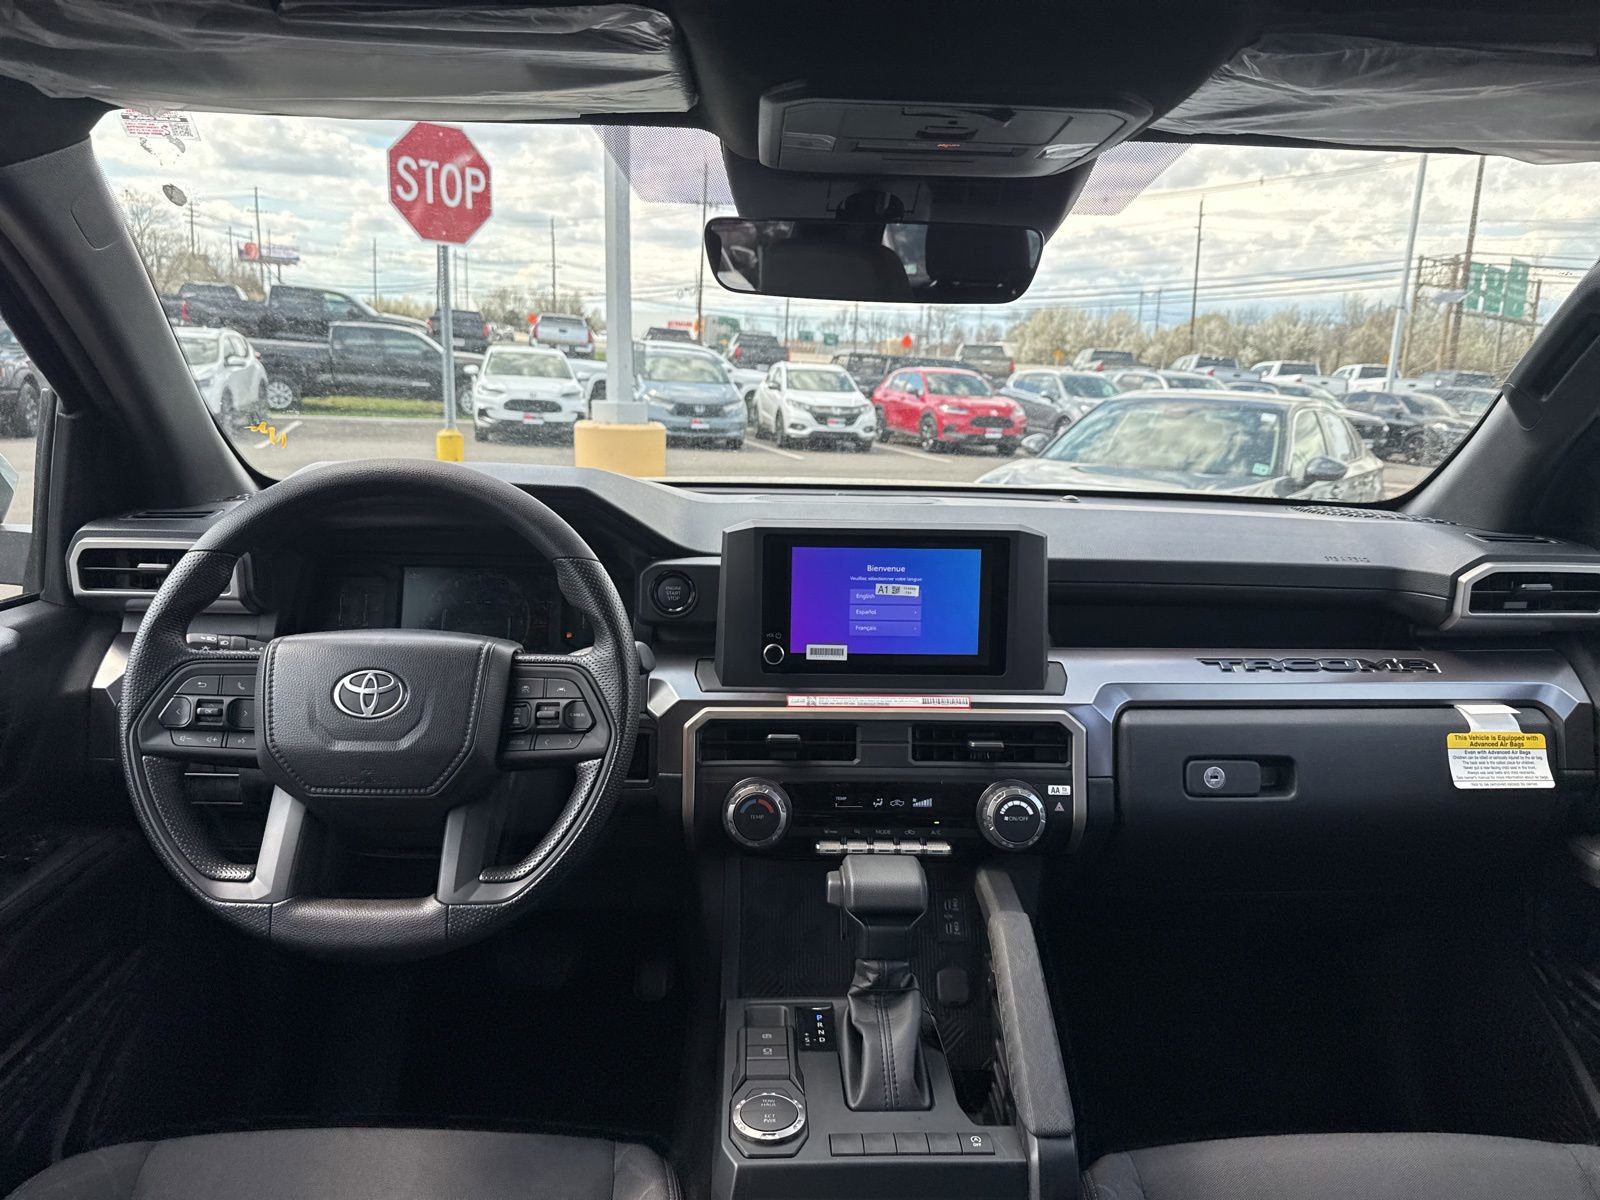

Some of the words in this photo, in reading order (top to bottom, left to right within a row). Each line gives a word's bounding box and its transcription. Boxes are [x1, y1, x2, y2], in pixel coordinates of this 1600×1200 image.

[396, 156, 486, 209] STOP
[877, 585, 889, 594] A1
[1195, 658, 1442, 673] TACOMA
[1051, 786, 1061, 794] AA
